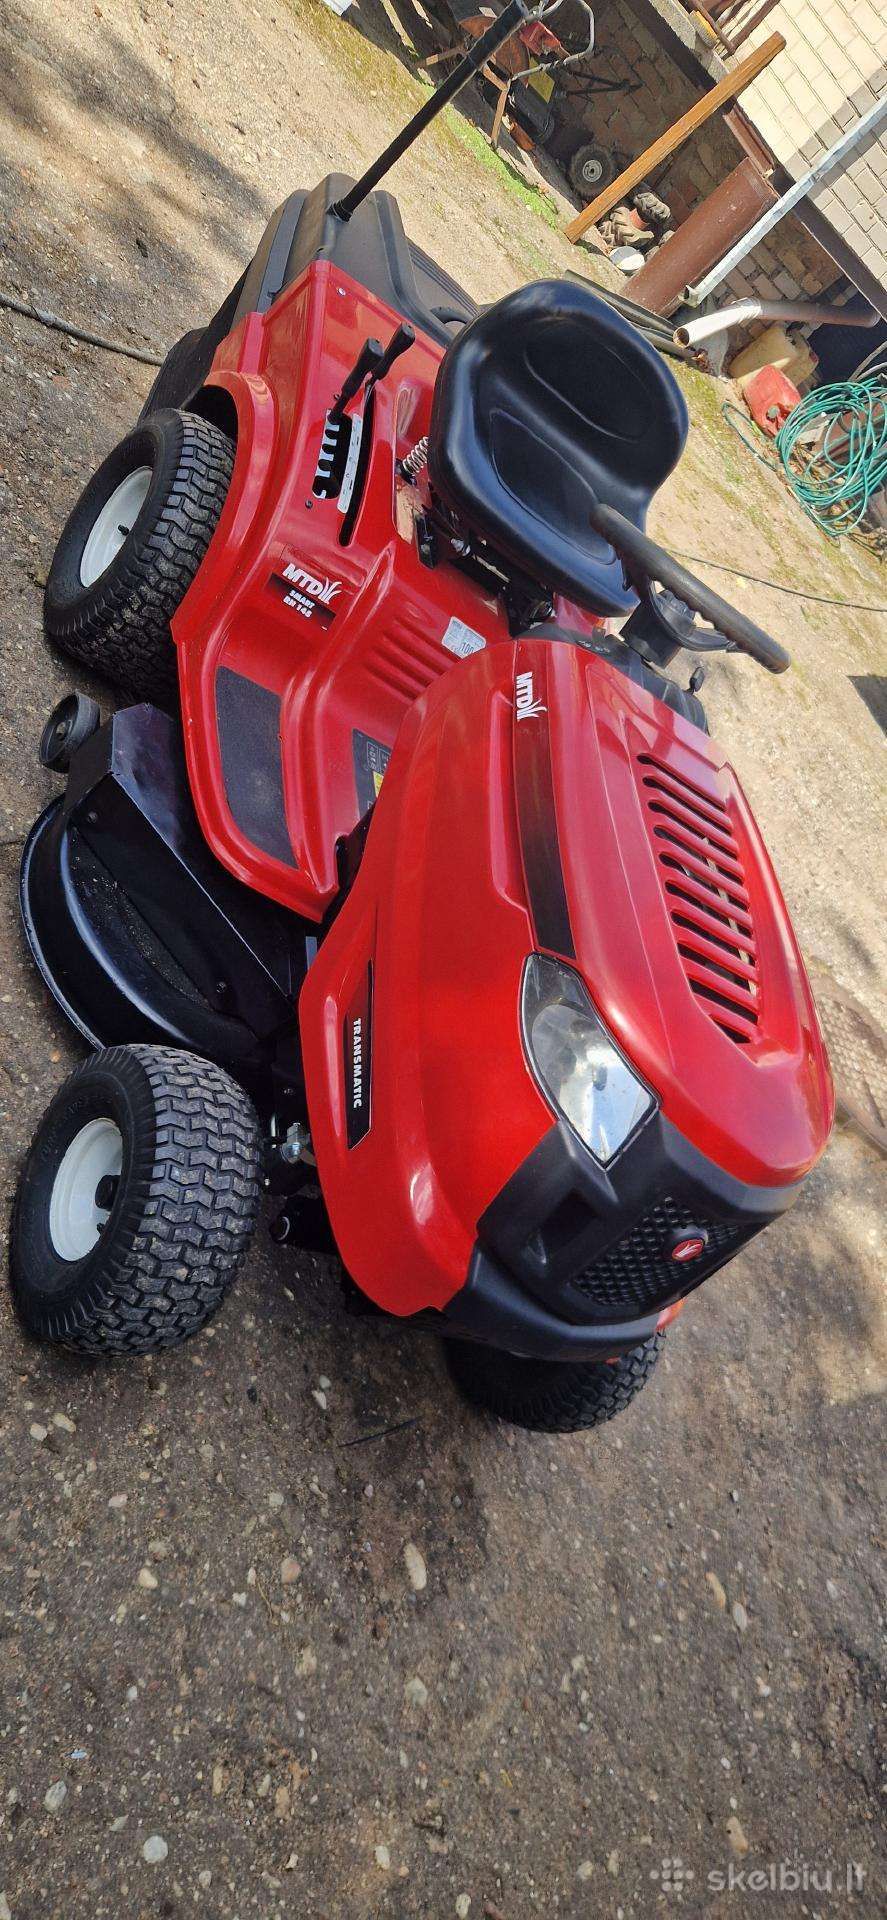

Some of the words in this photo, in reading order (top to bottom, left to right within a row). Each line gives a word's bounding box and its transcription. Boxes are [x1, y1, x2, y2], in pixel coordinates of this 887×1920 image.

[282, 563, 324, 596] MTD
[290, 590, 315, 608] SMART
[516, 671, 534, 709] MTD
[353, 1017, 363, 1109] TRANSMATIC
